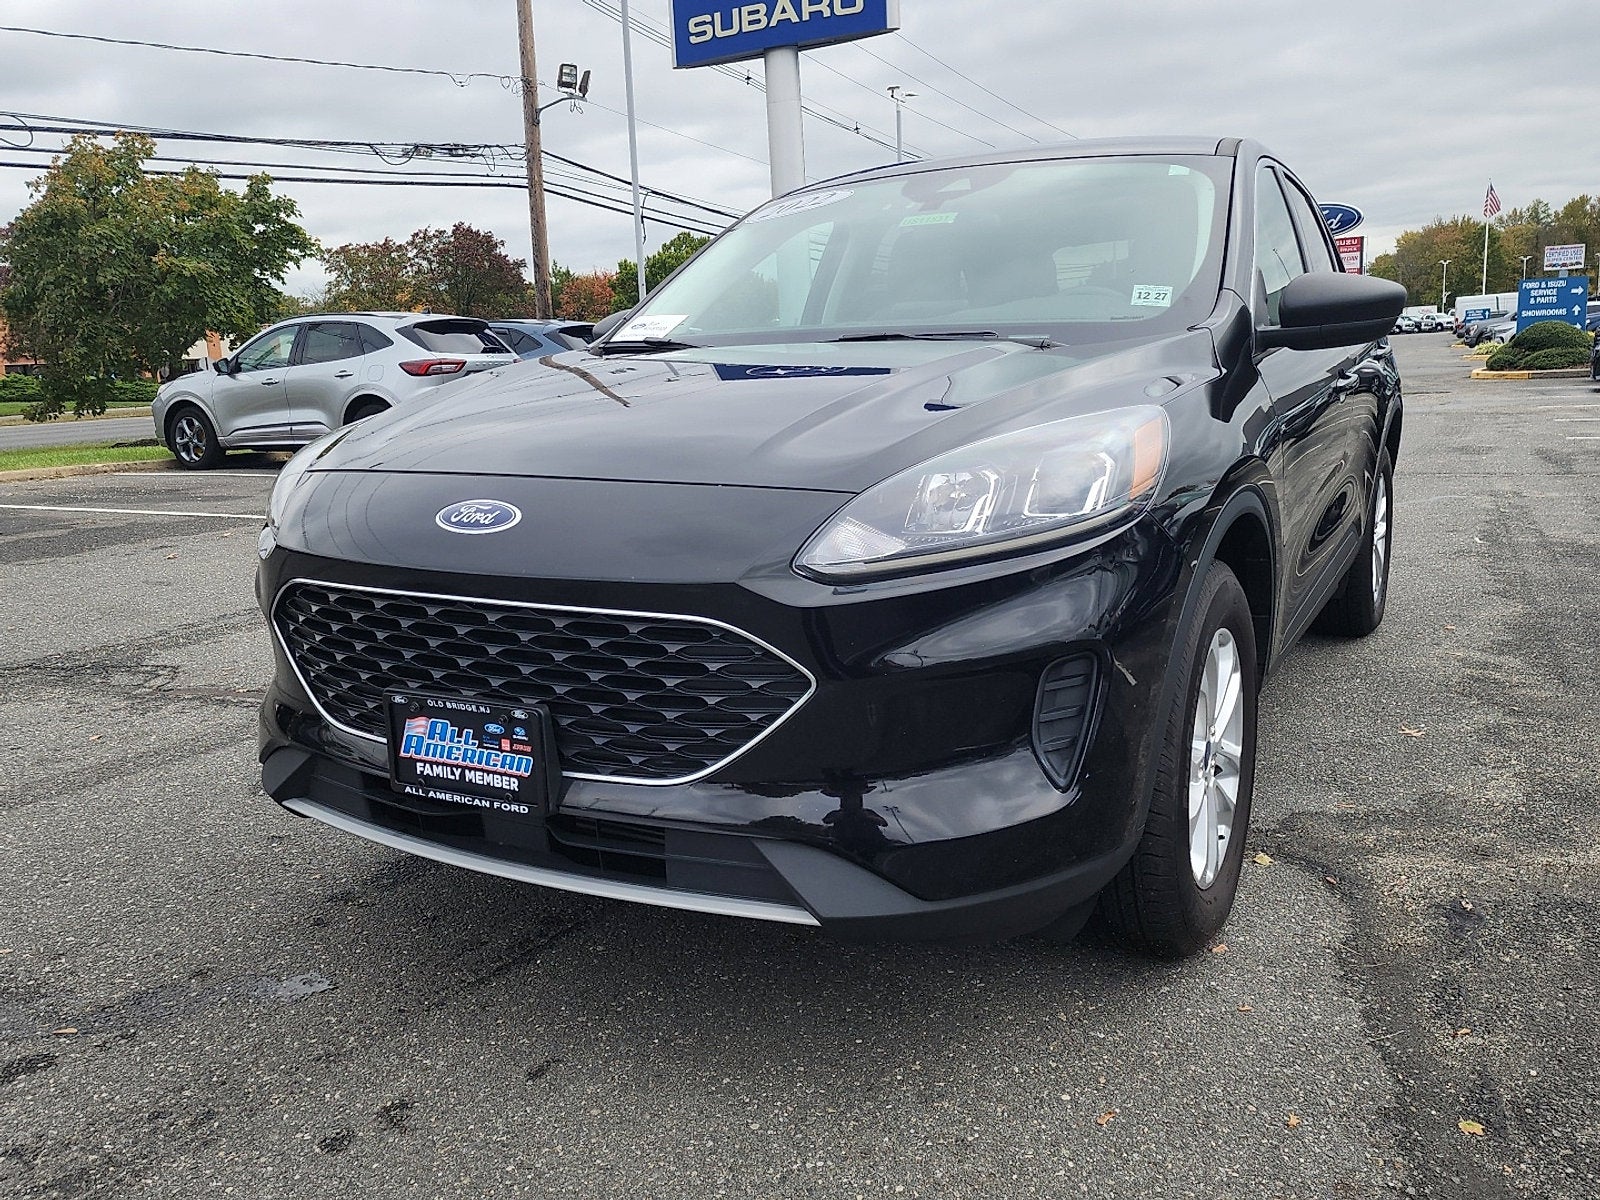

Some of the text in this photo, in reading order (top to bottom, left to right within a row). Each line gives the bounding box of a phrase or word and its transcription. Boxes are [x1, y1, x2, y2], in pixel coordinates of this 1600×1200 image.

[688, 0, 864, 44] SUBARU
[1522, 281, 1540, 290] FORD
[1547, 280, 1567, 288] ISUZU
[1136, 291, 1168, 301] 12 27
[1530, 288, 1558, 297] SERVICE
[1529, 296, 1557, 305] & PARTS
[1521, 308, 1567, 317] SHOWROOMS
[450, 504, 500, 525] Ford
[427, 699, 444, 708] OLD
[416, 762, 519, 792] FAMILY MEMBER
[405, 786, 529, 814] ALL AMERICAN FORD
